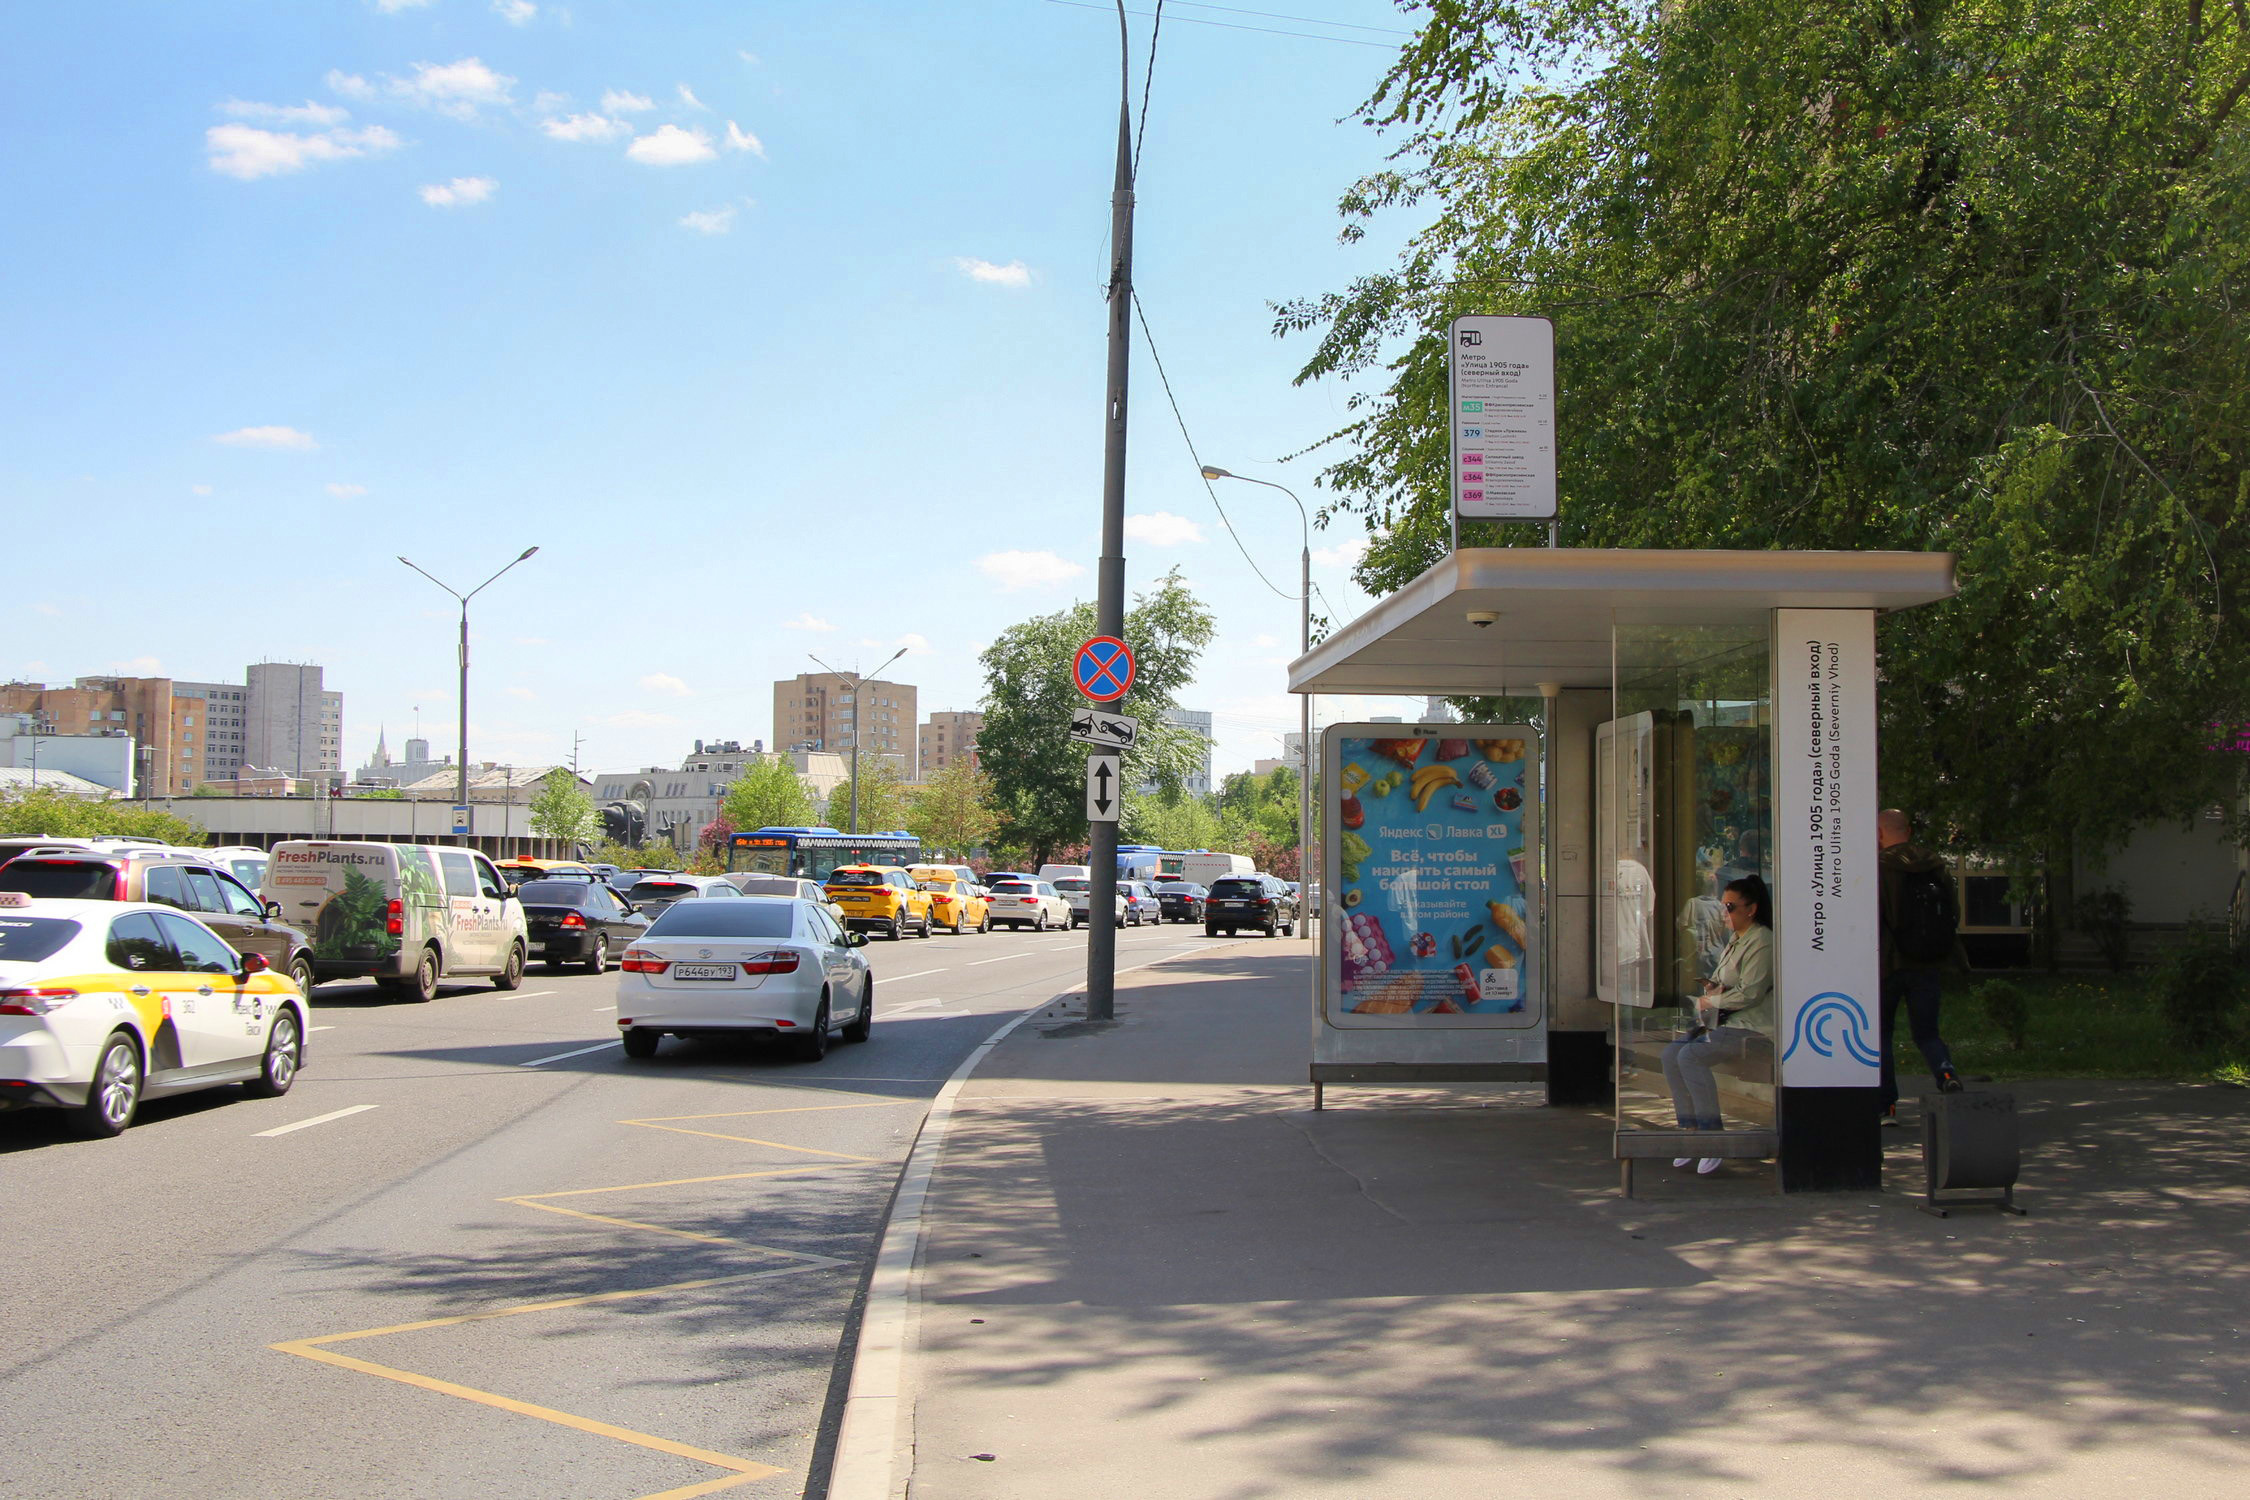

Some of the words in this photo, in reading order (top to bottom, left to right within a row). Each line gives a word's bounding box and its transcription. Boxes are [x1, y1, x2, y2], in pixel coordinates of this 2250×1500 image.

[1461, 353, 1486, 361] Метро
[1461, 361, 1488, 369] «Улица
[1489, 361, 1508, 369] 1905
[1463, 429, 1481, 437] 379
[1805, 640, 1822, 679] вход)
[1826, 642, 1841, 680] Vhod)
[1807, 682, 1824, 758] (северный
[1827, 682, 1843, 742] (Severniy
[1828, 745, 1841, 780] Goda
[1811, 761, 1825, 802] года»
[1829, 782, 1842, 814] 1905
[1379, 826, 1424, 838] Яндекс
[1446, 826, 1483, 838] Лавка
[1489, 826, 1505, 837] XL
[1809, 805, 1824, 841] 1905
[1829, 817, 1842, 855] Ulitsa
[277, 850, 385, 866] FreshPlants.ru
[1391, 850, 1424, 863] Всё,
[1427, 850, 1477, 862] чтобы
[1444, 864, 1496, 876] самый
[1810, 844, 1826, 899] «Улица
[1454, 880, 1490, 890] стол
[1830, 857, 1842, 899] Metro
[456, 914, 508, 932] FreshPlants.ru
[1433, 910, 1470, 919] районе
[1811, 901, 1828, 952] Метро
[717, 967, 733, 975] 193
